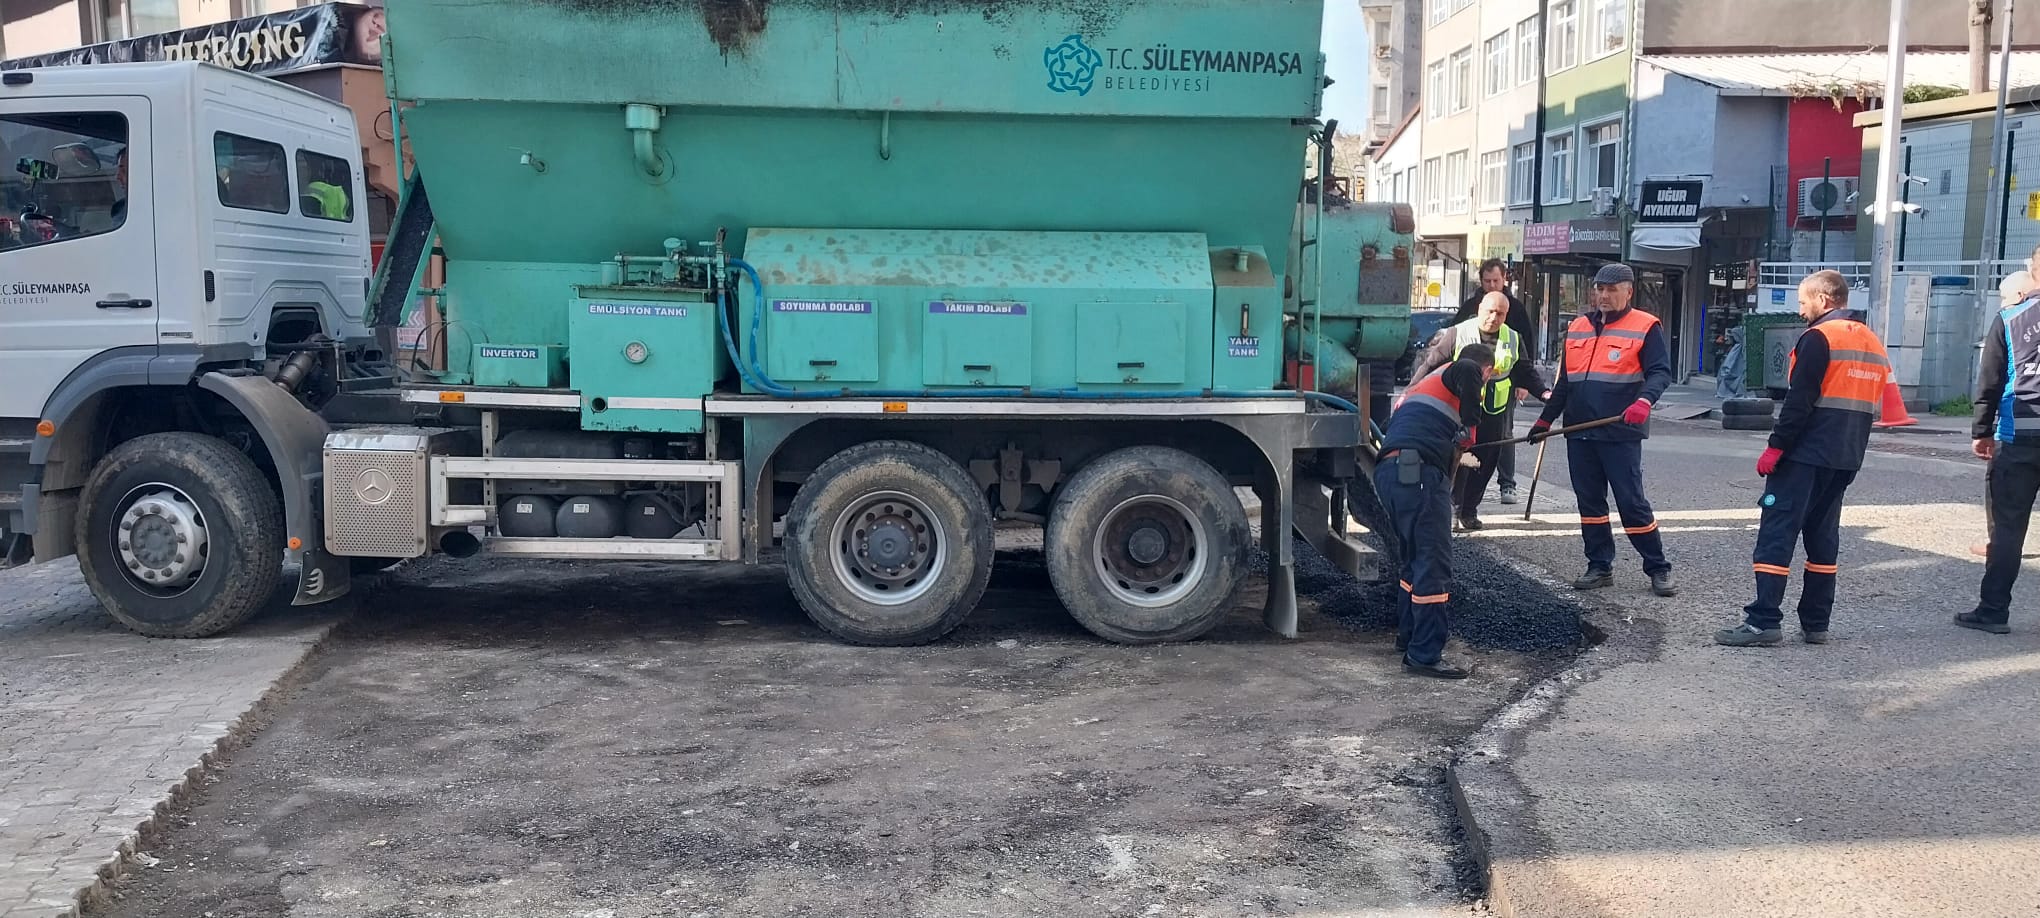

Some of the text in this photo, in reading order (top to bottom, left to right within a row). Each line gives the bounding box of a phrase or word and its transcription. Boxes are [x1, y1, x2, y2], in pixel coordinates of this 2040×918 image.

[1106, 43, 1303, 76] T.C. SÜLEYMANPAŞA
[1105, 75, 1210, 92] BELEDİYESİ
[1657, 186, 1687, 202] UĞUR
[1643, 204, 1697, 217] AYAKKABI
[12, 281, 91, 295] SÜLEYMANPAŞA
[0, 296, 48, 304] ELEDİYESİ
[589, 304, 687, 317] EMÜLSİYON TANKI
[780, 301, 865, 313] SOYUNMA DOLABI
[945, 303, 974, 313] TAKIM
[1230, 337, 1259, 346] YAKIT
[482, 347, 536, 358] İNVERTÖR
[1229, 348, 1258, 357] TANKI
